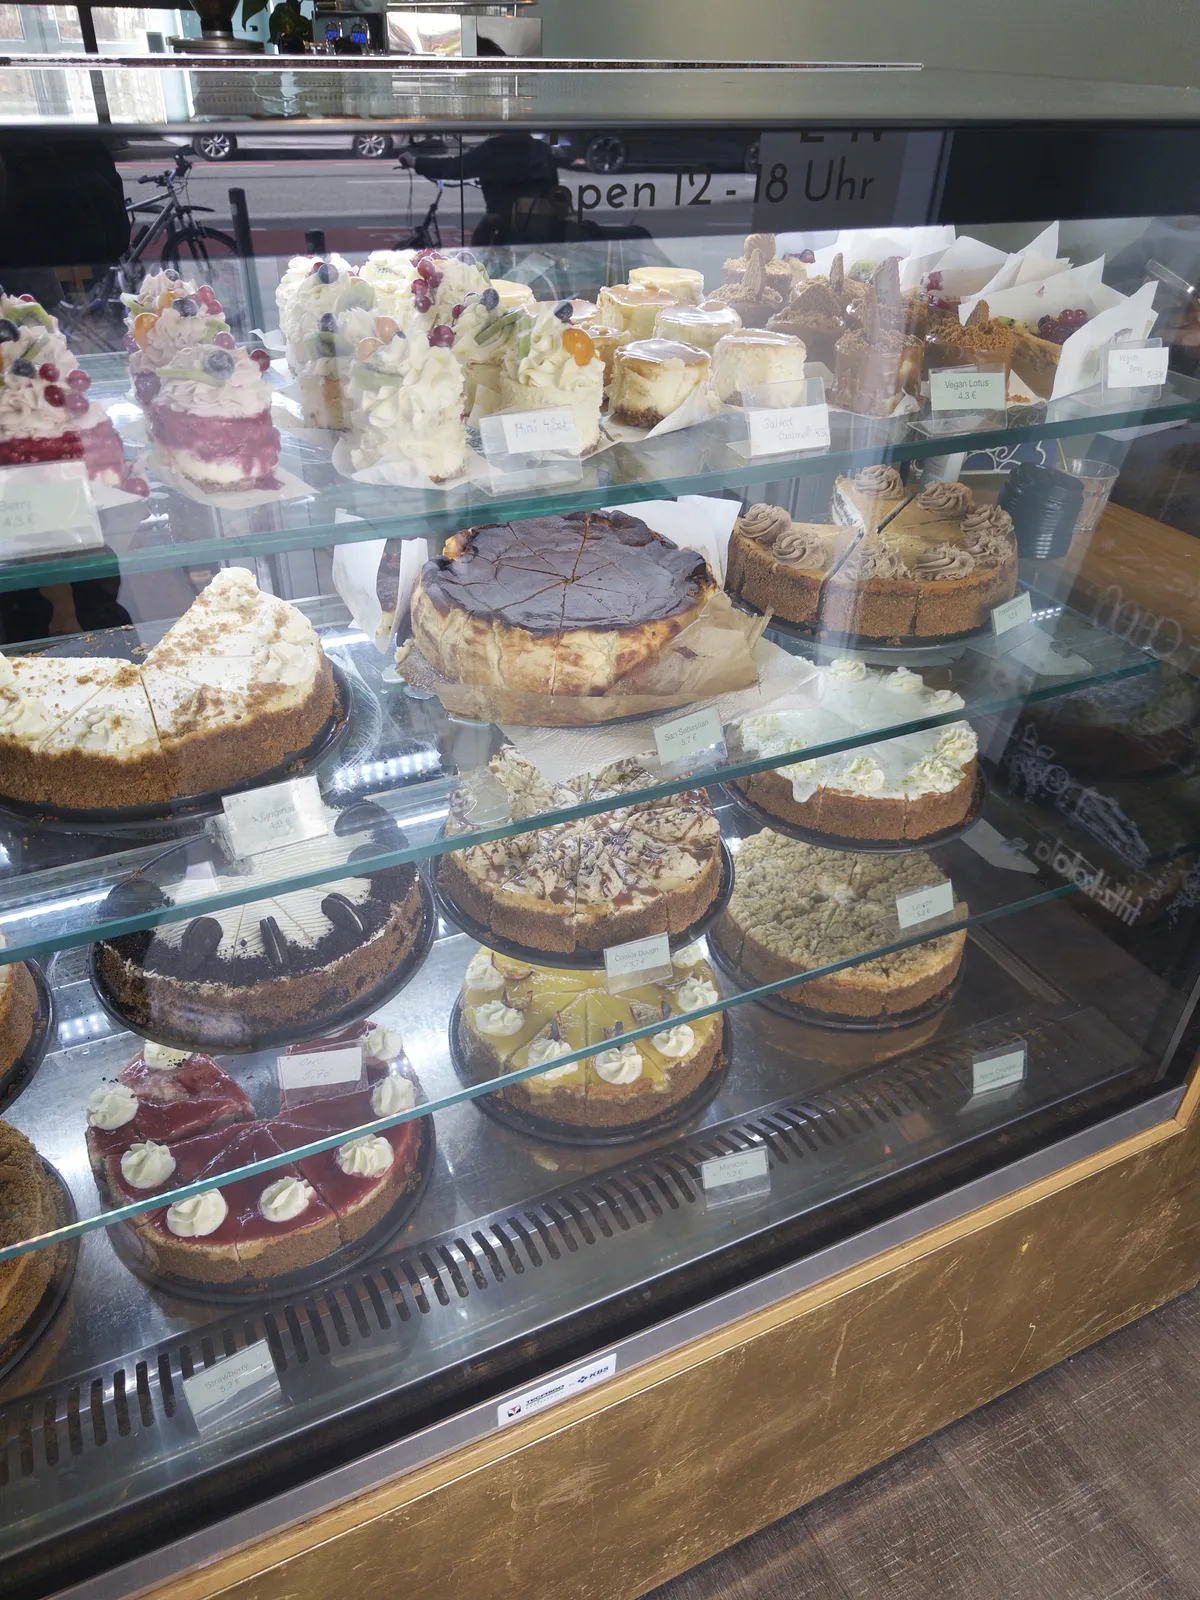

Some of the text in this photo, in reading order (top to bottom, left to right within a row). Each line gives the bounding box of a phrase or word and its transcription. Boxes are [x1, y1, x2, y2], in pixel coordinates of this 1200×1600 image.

[547, 181, 656, 224] open
[675, 163, 712, 207] 12
[753, 162, 788, 204] 18
[804, 156, 875, 202] Uhr
[944, 379, 989, 391] Vegan Lotus
[514, 418, 538, 438] Mini
[664, 719, 710, 742] San Sebastian
[614, 947, 659, 962] Cookie Dough
[204, 1362, 250, 1390] Strawberry
[589, 1365, 609, 1379] KBS
